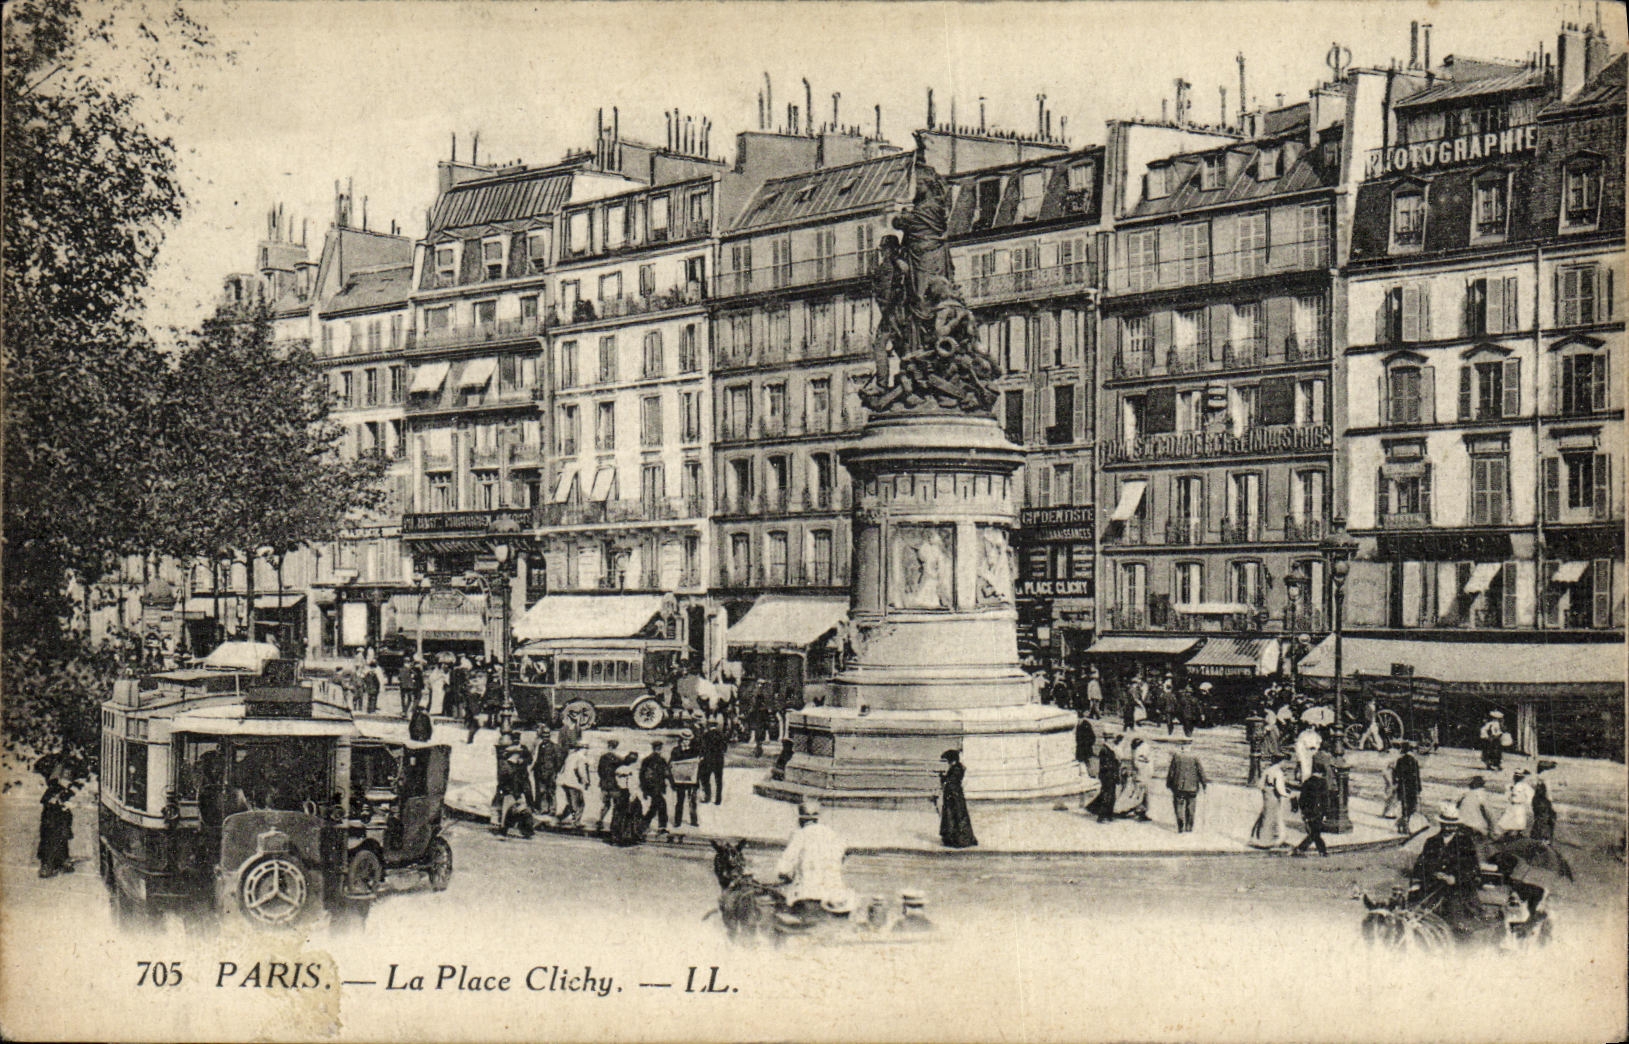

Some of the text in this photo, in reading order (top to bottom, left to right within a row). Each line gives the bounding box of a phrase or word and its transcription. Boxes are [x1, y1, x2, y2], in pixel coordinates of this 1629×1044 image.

[1366, 126, 1537, 178] PHOTOGRAPHIE
[1041, 507, 1094, 523] DENTISTE
[1025, 581, 1053, 595] PLACE
[1056, 580, 1087, 595] CLICHY
